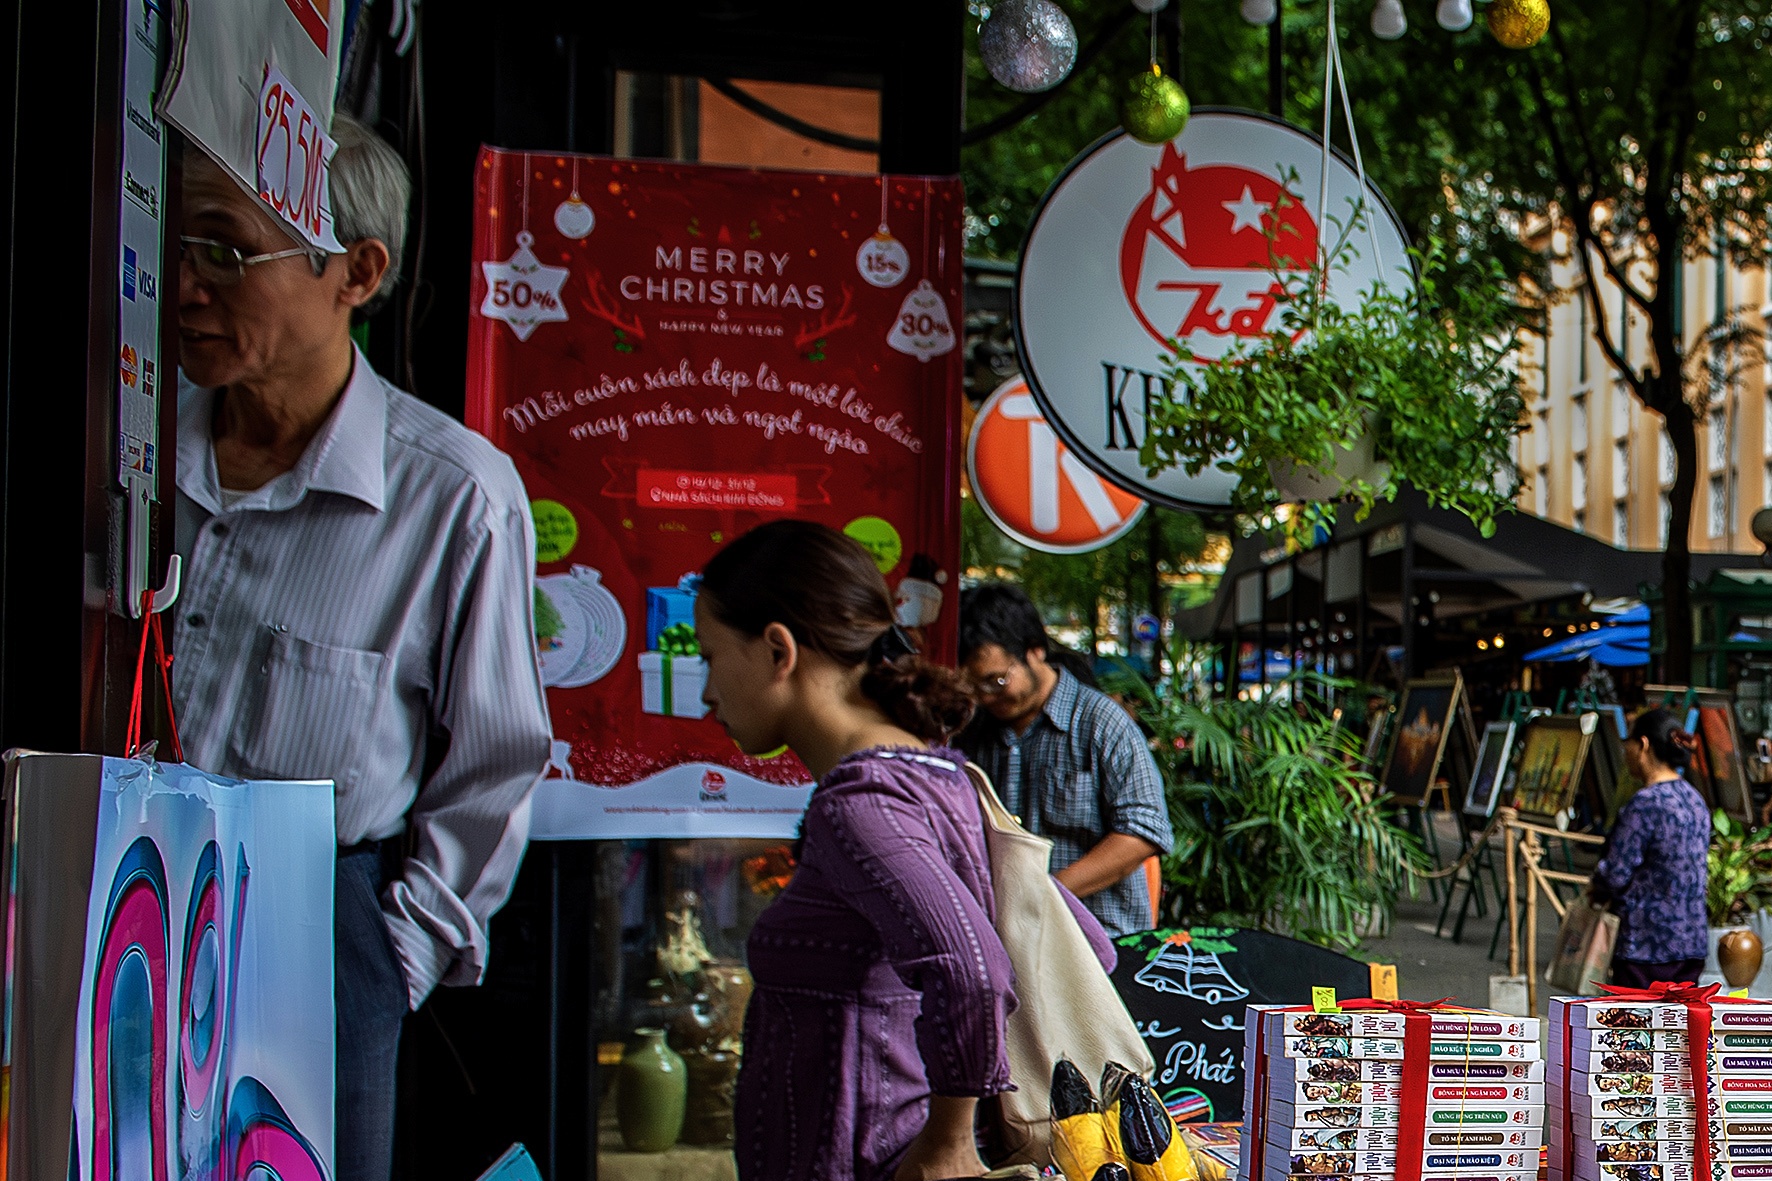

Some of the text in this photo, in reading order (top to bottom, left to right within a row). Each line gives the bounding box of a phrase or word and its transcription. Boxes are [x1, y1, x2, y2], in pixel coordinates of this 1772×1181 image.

[654, 244, 791, 277] MERRY
[493, 278, 556, 311] 50%
[619, 275, 826, 310] CHRISTMAS
[709, 322, 744, 336] NEW
[747, 324, 785, 338] YEAR
[901, 312, 949, 338] 30%
[643, 357, 700, 392] sách
[755, 361, 784, 393] là
[568, 411, 630, 442] may
[701, 405, 740, 426] và
[1160, 1041, 1237, 1085] Phát
